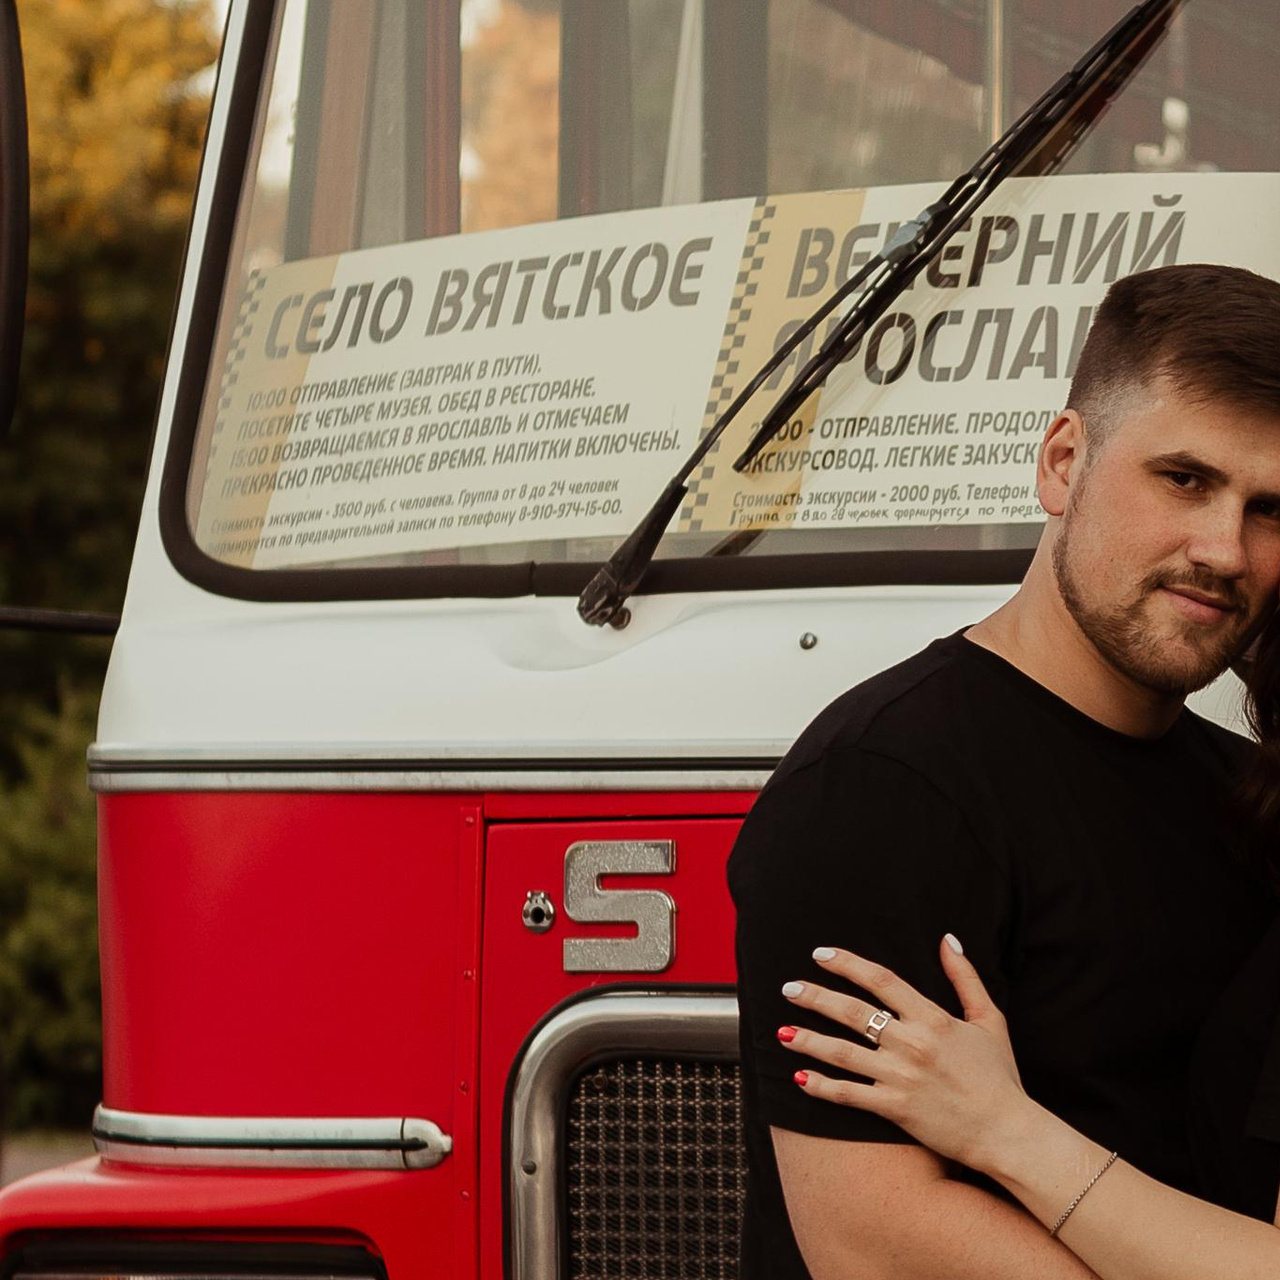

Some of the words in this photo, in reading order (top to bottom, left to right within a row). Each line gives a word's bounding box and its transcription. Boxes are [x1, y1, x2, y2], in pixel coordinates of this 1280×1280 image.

[785, 194, 1187, 299] ВЕЕРНИЙ
[264, 276, 413, 359] СЕЛО
[425, 237, 713, 337] ВЯТСКОЕ
[237, 410, 311, 440] ПОСЕТИТЕ
[315, 401, 376, 429] ЧЕТЫРЕ
[377, 395, 432, 421] МУЗЕЯ.
[438, 389, 482, 413] ОБЕД
[485, 387, 497, 407] В
[500, 377, 596, 407] РЕСТОРАНЕ.
[246, 388, 286, 412] 10:00
[290, 371, 398, 405] ОТПРАВЛЕНИЕ
[399, 361, 475, 392] (ЗАВТРАК
[476, 360, 488, 380] В
[271, 427, 400, 463] ВОЗВРАЩАЕМСЯ
[401, 425, 414, 446] В
[416, 414, 512, 445] ЯРОСЛАВЛЬ
[516, 412, 529, 433] И
[533, 403, 630, 432] ОТМЕЧАЕМ
[820, 413, 959, 440] ОТПРАВЛЕНИЕ.
[965, 410, 1063, 436] ПРОДОЛ
[221, 467, 309, 498] ПРЕКРАСНО
[310, 453, 425, 487] ПРОВЕДЕННОЕ
[427, 449, 487, 473] ВРЕМЯ.
[492, 437, 572, 465] НАПИТКИ
[574, 429, 681, 458] ВКЛЮЧЕНЫ.
[743, 446, 878, 475] КСКУРСОВОД.
[884, 444, 959, 468] ЛЕГКИЕ
[962, 442, 1042, 466] ЗАКУСК
[268, 508, 323, 529] экскурсии
[332, 501, 362, 518] 3500
[458, 488, 499, 509] Группа
[502, 487, 516, 500] от
[518, 484, 528, 498] 8
[529, 483, 546, 501] до
[548, 480, 567, 497] 24
[568, 479, 619, 495] человек
[733, 490, 803, 508] Стоимость
[807, 490, 877, 510] экскурсии
[889, 485, 930, 502] 2000
[932, 484, 961, 505] руб.
[966, 483, 1029, 503] Телефон
[978, 506, 995, 516] по
[278, 532, 293, 547] по
[295, 521, 395, 548] предварительной
[396, 517, 436, 533] записи
[438, 515, 454, 529] по
[457, 508, 516, 528] телефону
